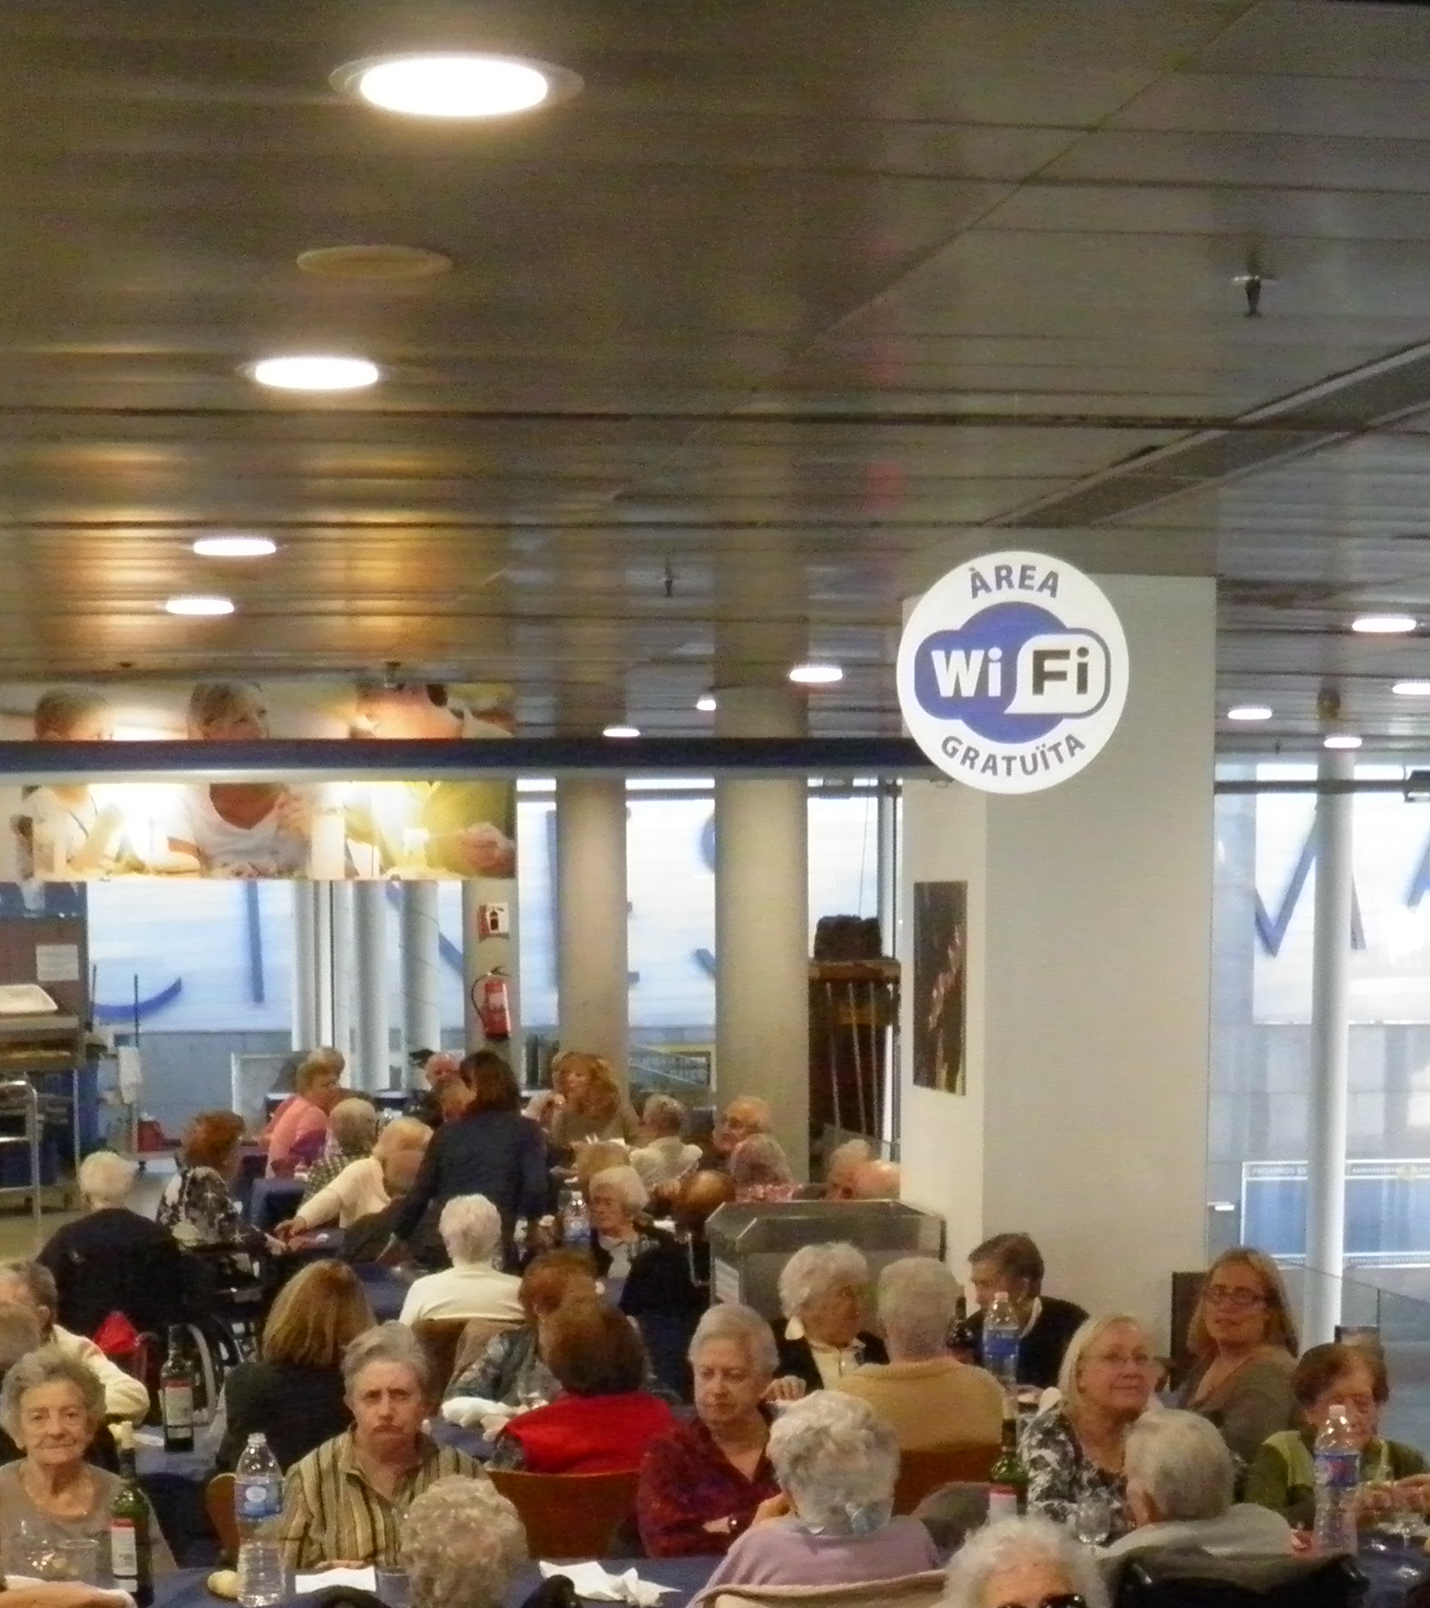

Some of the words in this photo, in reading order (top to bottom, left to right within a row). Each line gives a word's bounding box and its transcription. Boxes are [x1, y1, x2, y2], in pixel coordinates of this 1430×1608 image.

[969, 563, 1060, 599] ÀREA
[931, 646, 1003, 698] Wi
[1031, 646, 1090, 696] Fi
[940, 732, 1086, 778] GRATUÏTA
